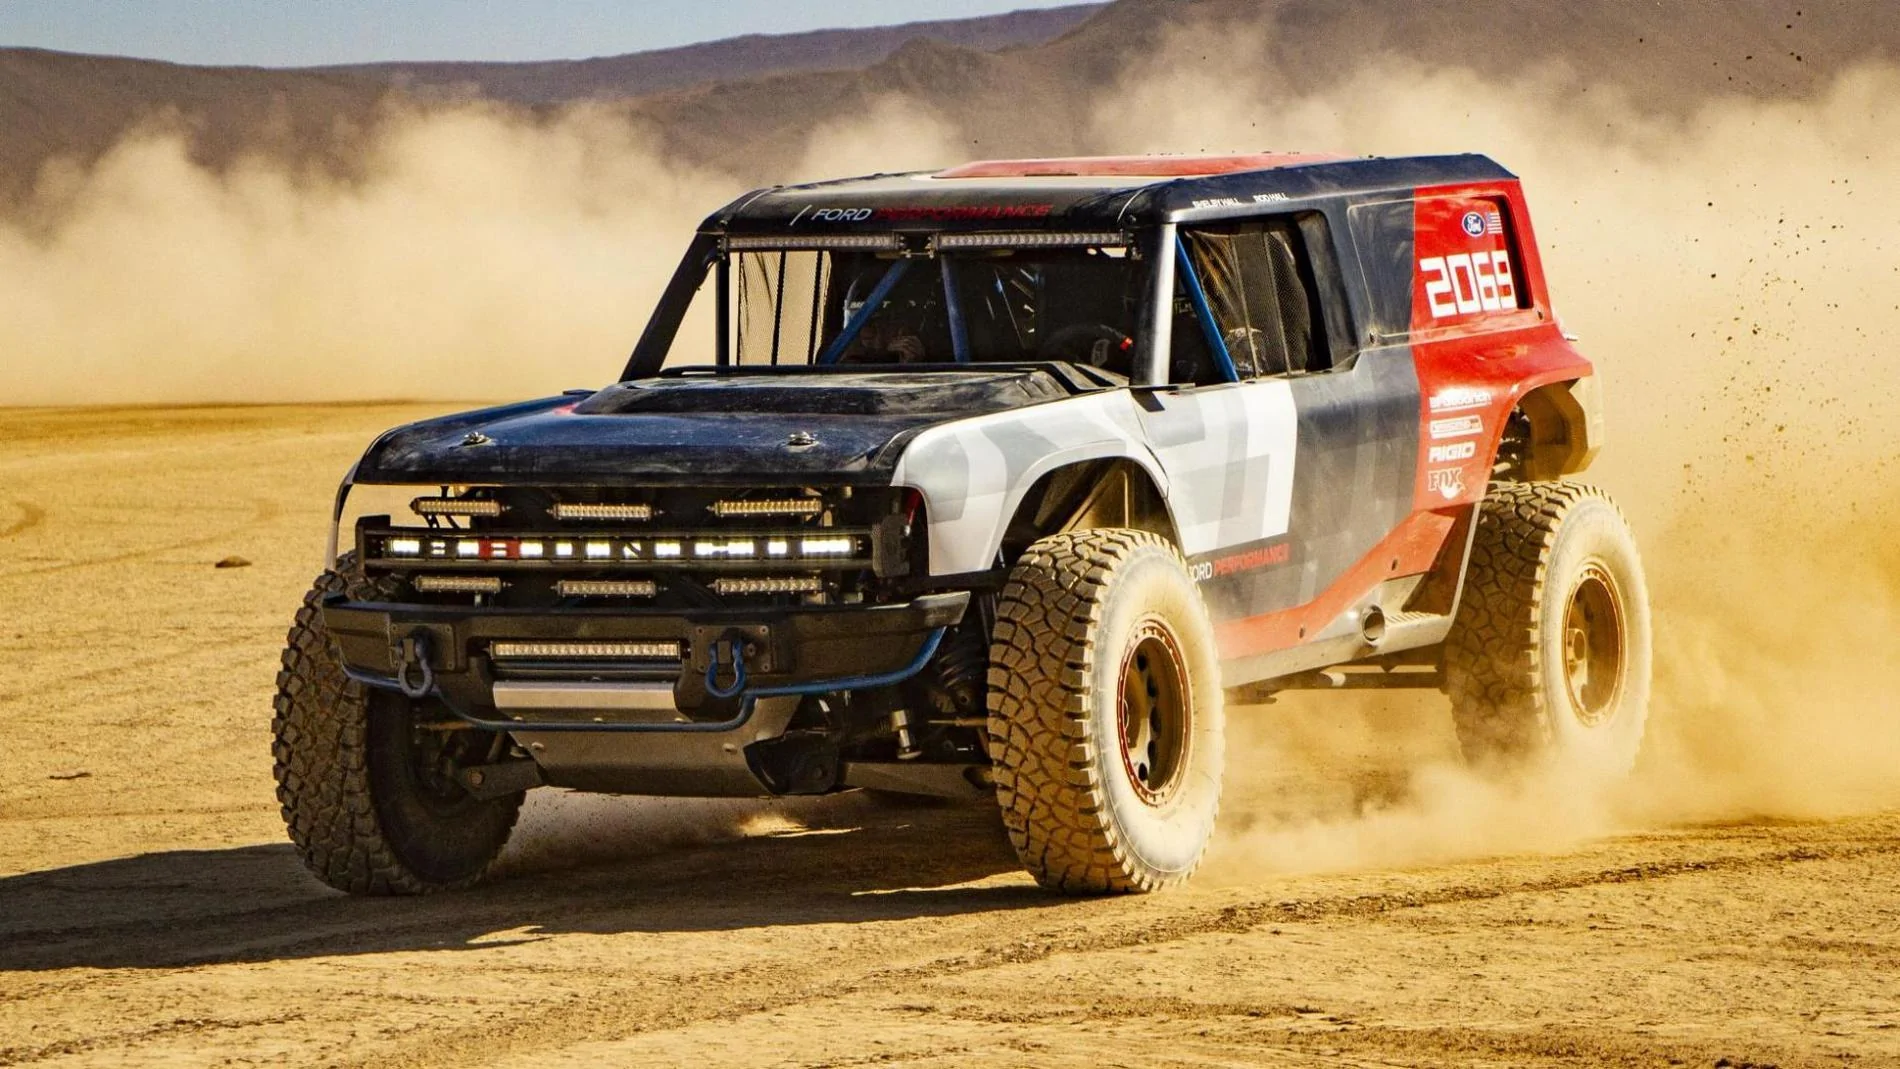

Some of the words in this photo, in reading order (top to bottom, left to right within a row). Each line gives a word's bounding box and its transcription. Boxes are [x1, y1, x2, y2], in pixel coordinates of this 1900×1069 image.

[811, 207, 872, 221] FORD
[874, 203, 1054, 221] PERFORMANCE
[1419, 250, 1517, 318] 2069
[1428, 441, 1476, 463] RIGID
[1427, 467, 1464, 493] FOX
[1213, 543, 1290, 576] PERFORMANCE
